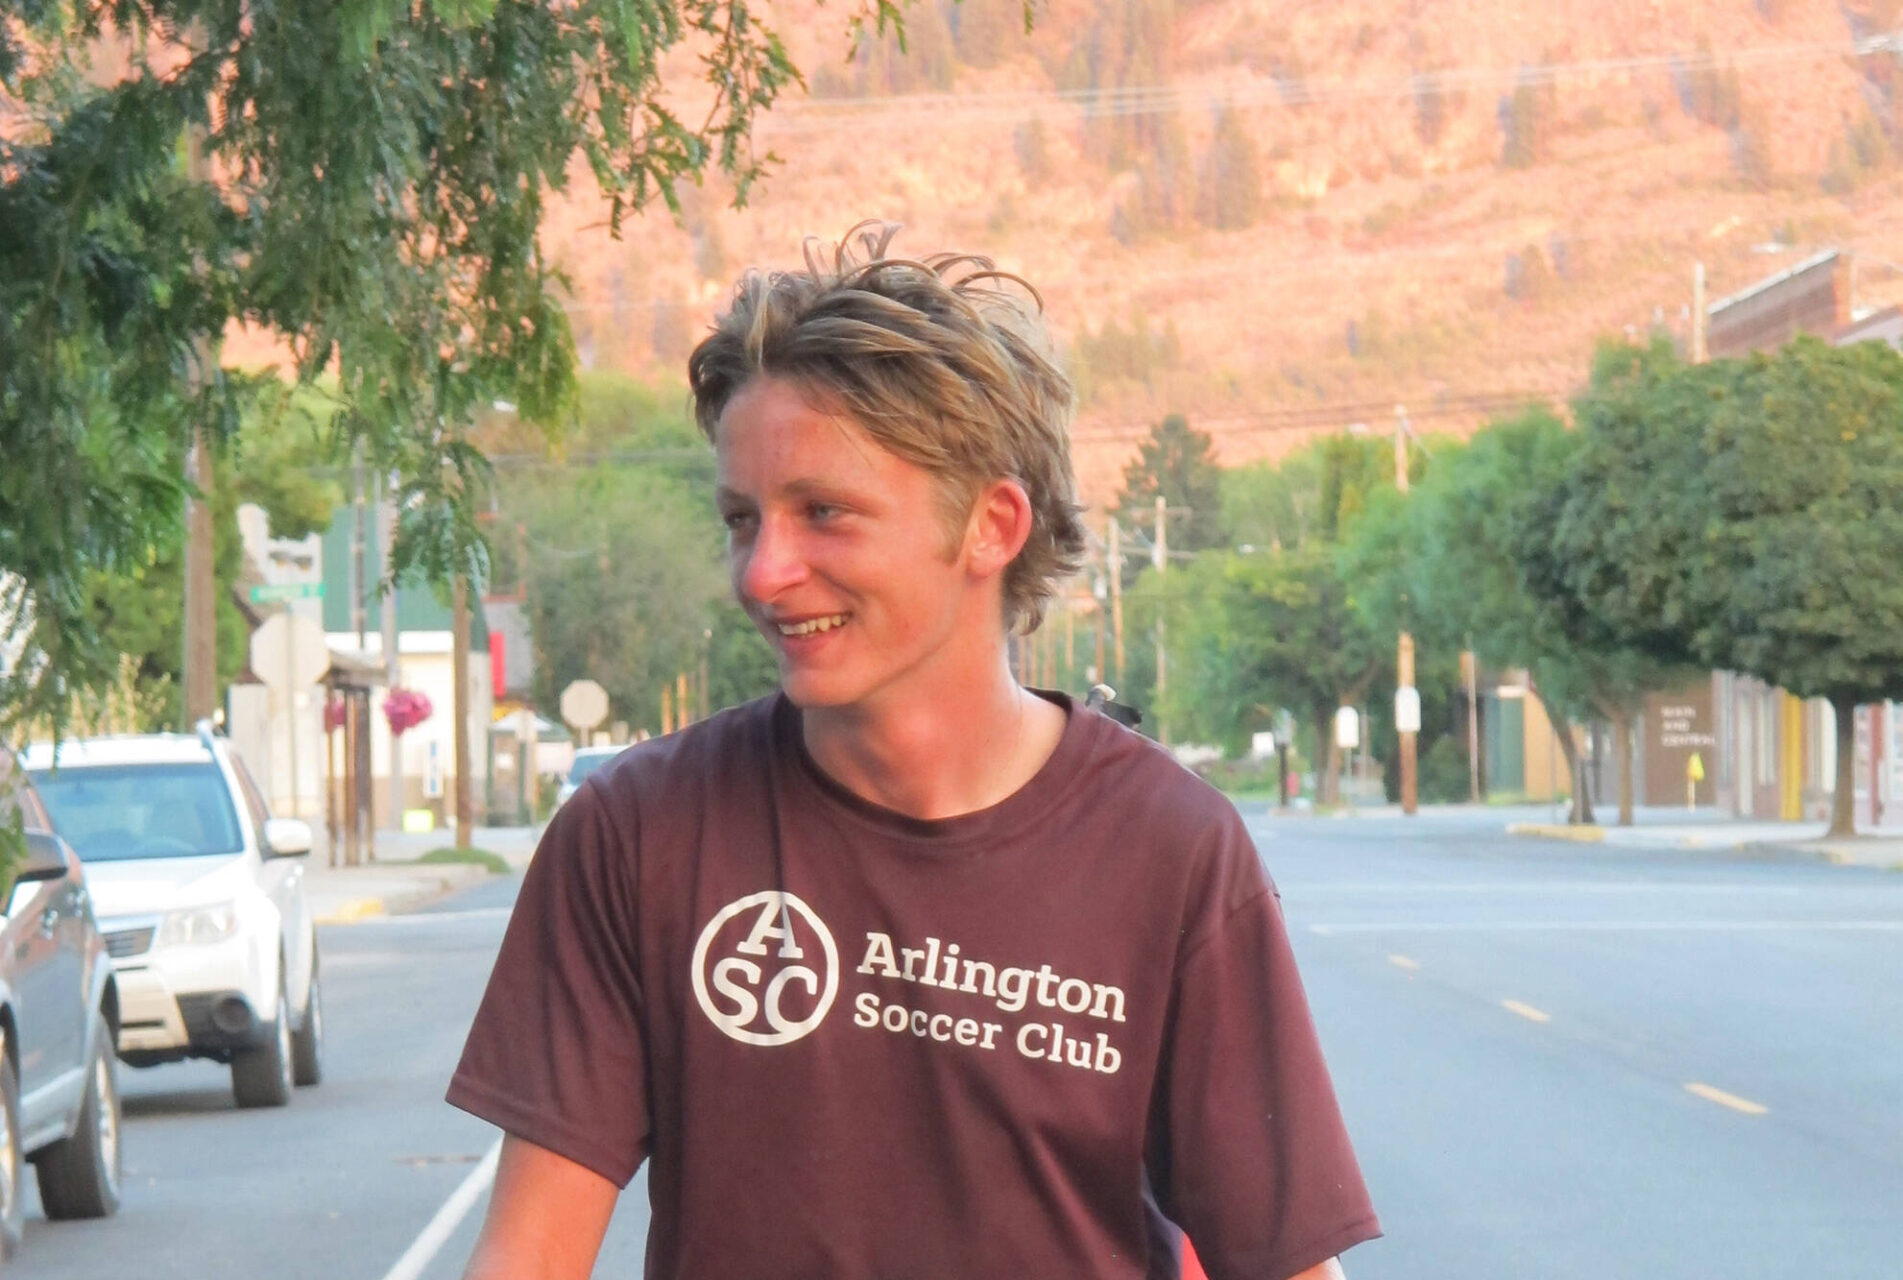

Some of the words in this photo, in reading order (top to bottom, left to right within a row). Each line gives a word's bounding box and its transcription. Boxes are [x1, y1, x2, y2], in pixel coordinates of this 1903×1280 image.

[856, 931, 1127, 1023] Arlington
[854, 992, 1003, 1050] Soccer
[1016, 1022, 1122, 1074] Club
